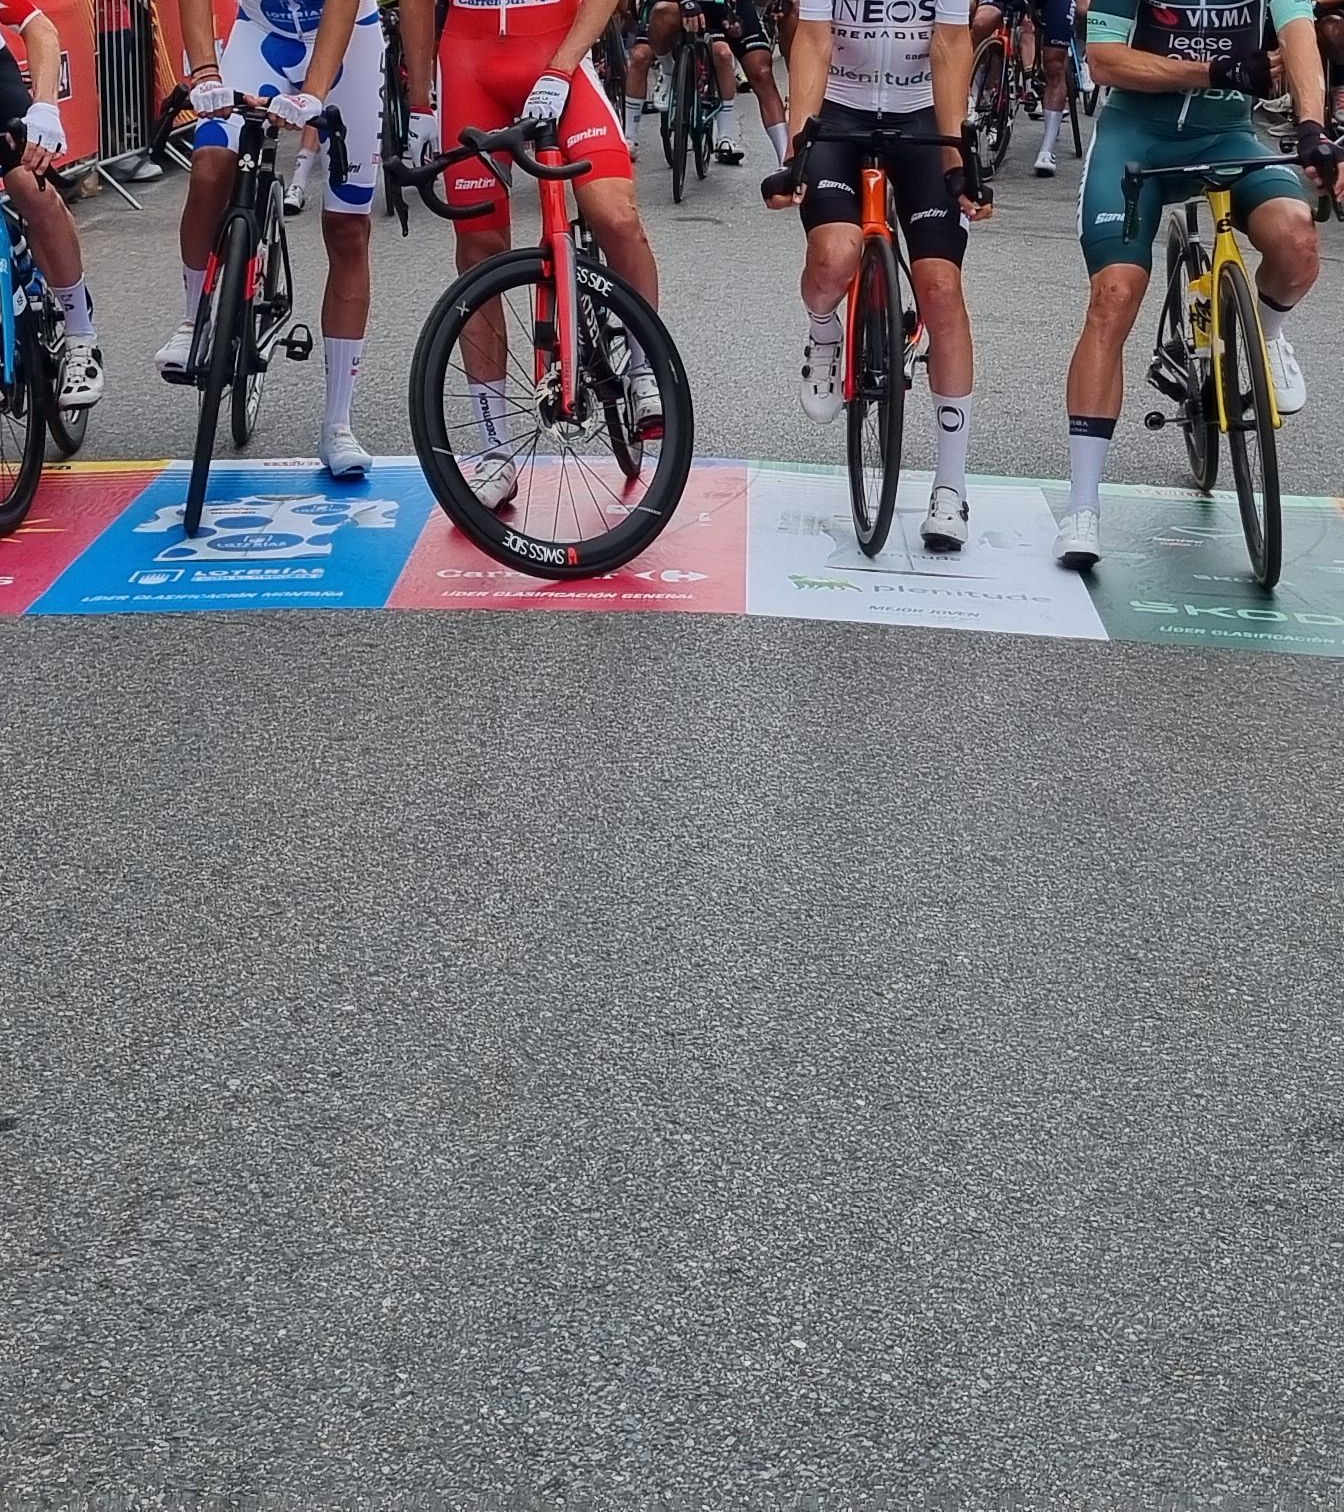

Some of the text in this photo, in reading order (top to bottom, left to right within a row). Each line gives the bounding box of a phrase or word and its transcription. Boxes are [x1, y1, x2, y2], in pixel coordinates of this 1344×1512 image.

[1186, 6, 1252, 28] VISMA
[1168, 34, 1233, 50] lease
[566, 126, 607, 149] Santini
[455, 177, 496, 190] Santini
[909, 208, 949, 224] Santini
[441, 590, 490, 598] LÍDER
[493, 590, 617, 601] CLASIFICACIÓN
[873, 585, 1051, 604] plenitude
[868, 604, 981, 620] MEJOR JOVEN
[1159, 625, 1206, 637] LÍDER
[1211, 629, 1335, 645] CLASIFICACIÓN
